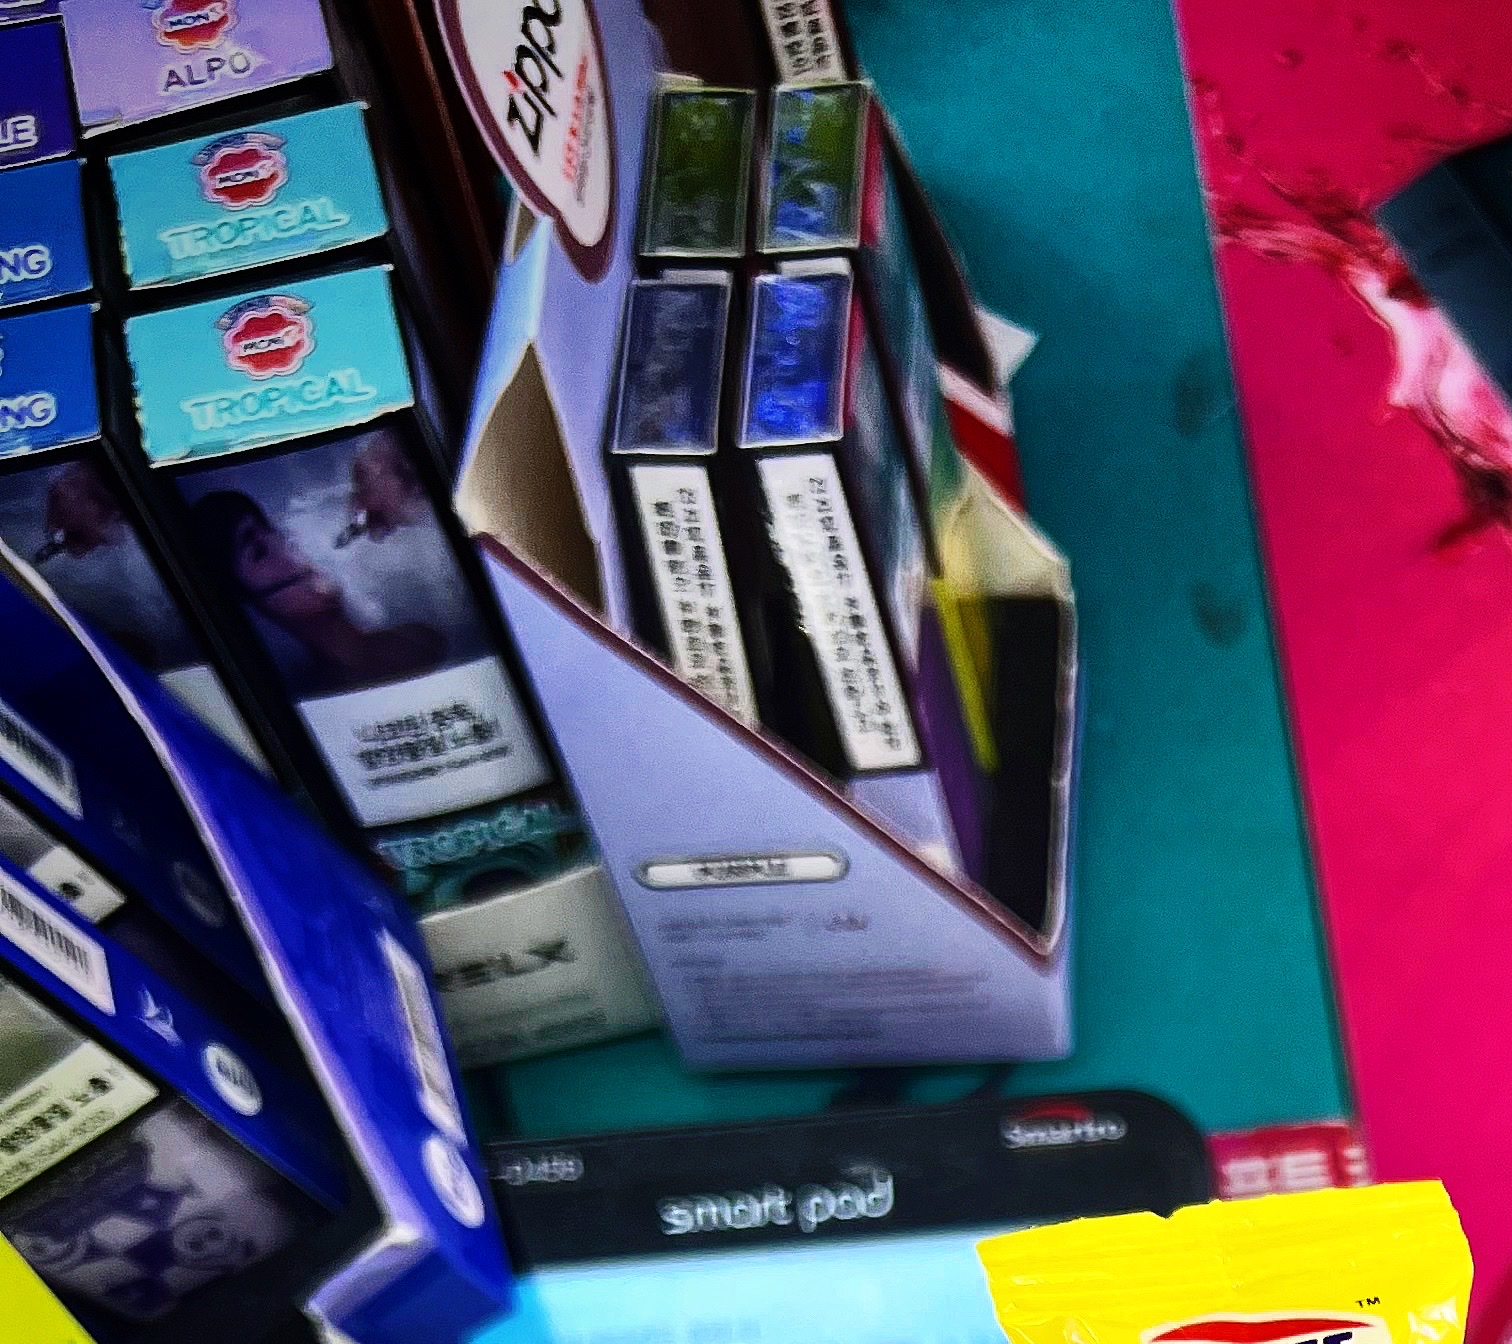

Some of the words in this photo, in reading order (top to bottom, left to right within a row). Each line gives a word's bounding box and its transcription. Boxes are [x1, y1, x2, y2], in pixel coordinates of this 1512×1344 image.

[163, 51, 251, 92] ALPO
[161, 200, 346, 257] TROPICAL
[181, 369, 374, 429] TROPICAL
[658, 1184, 793, 1235] smart
[799, 1164, 895, 1232] pod
